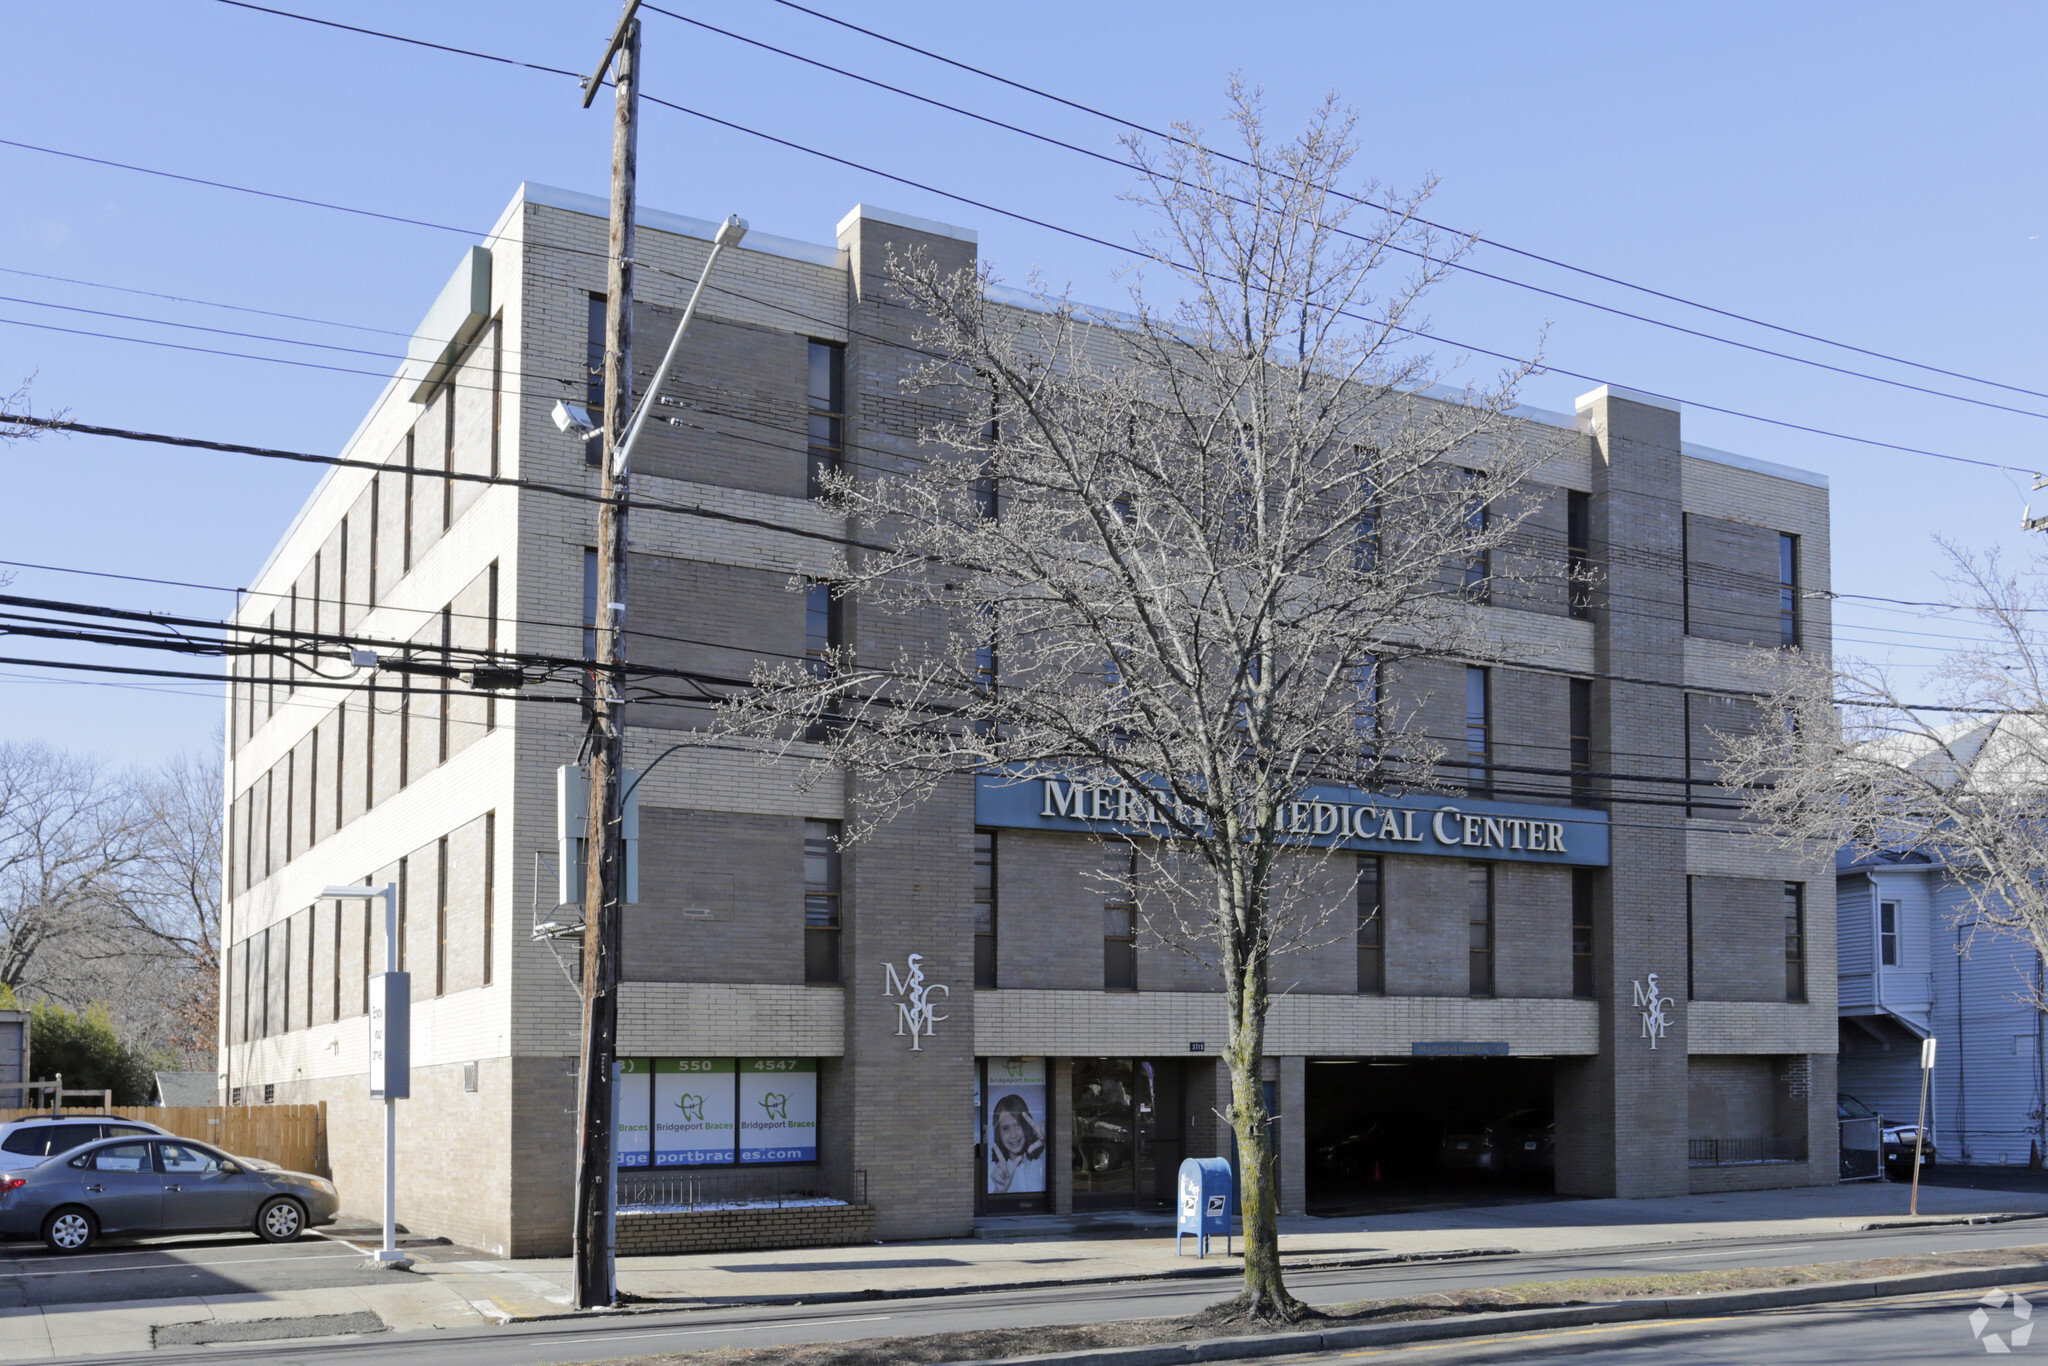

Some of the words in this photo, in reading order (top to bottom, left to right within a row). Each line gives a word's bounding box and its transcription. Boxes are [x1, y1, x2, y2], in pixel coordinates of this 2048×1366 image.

[1432, 806, 1568, 853] CENTER
[679, 1060, 712, 1071] 550
[754, 1060, 798, 1070] 4547
[618, 1123, 649, 1132] Braces
[656, 1122, 703, 1132] Bridgeport
[705, 1122, 734, 1130] Braces
[741, 1121, 786, 1131] Bridgeport
[788, 1120, 816, 1128] Braces
[656, 1150, 733, 1164] portbrac
[742, 1150, 802, 1160] es.com
